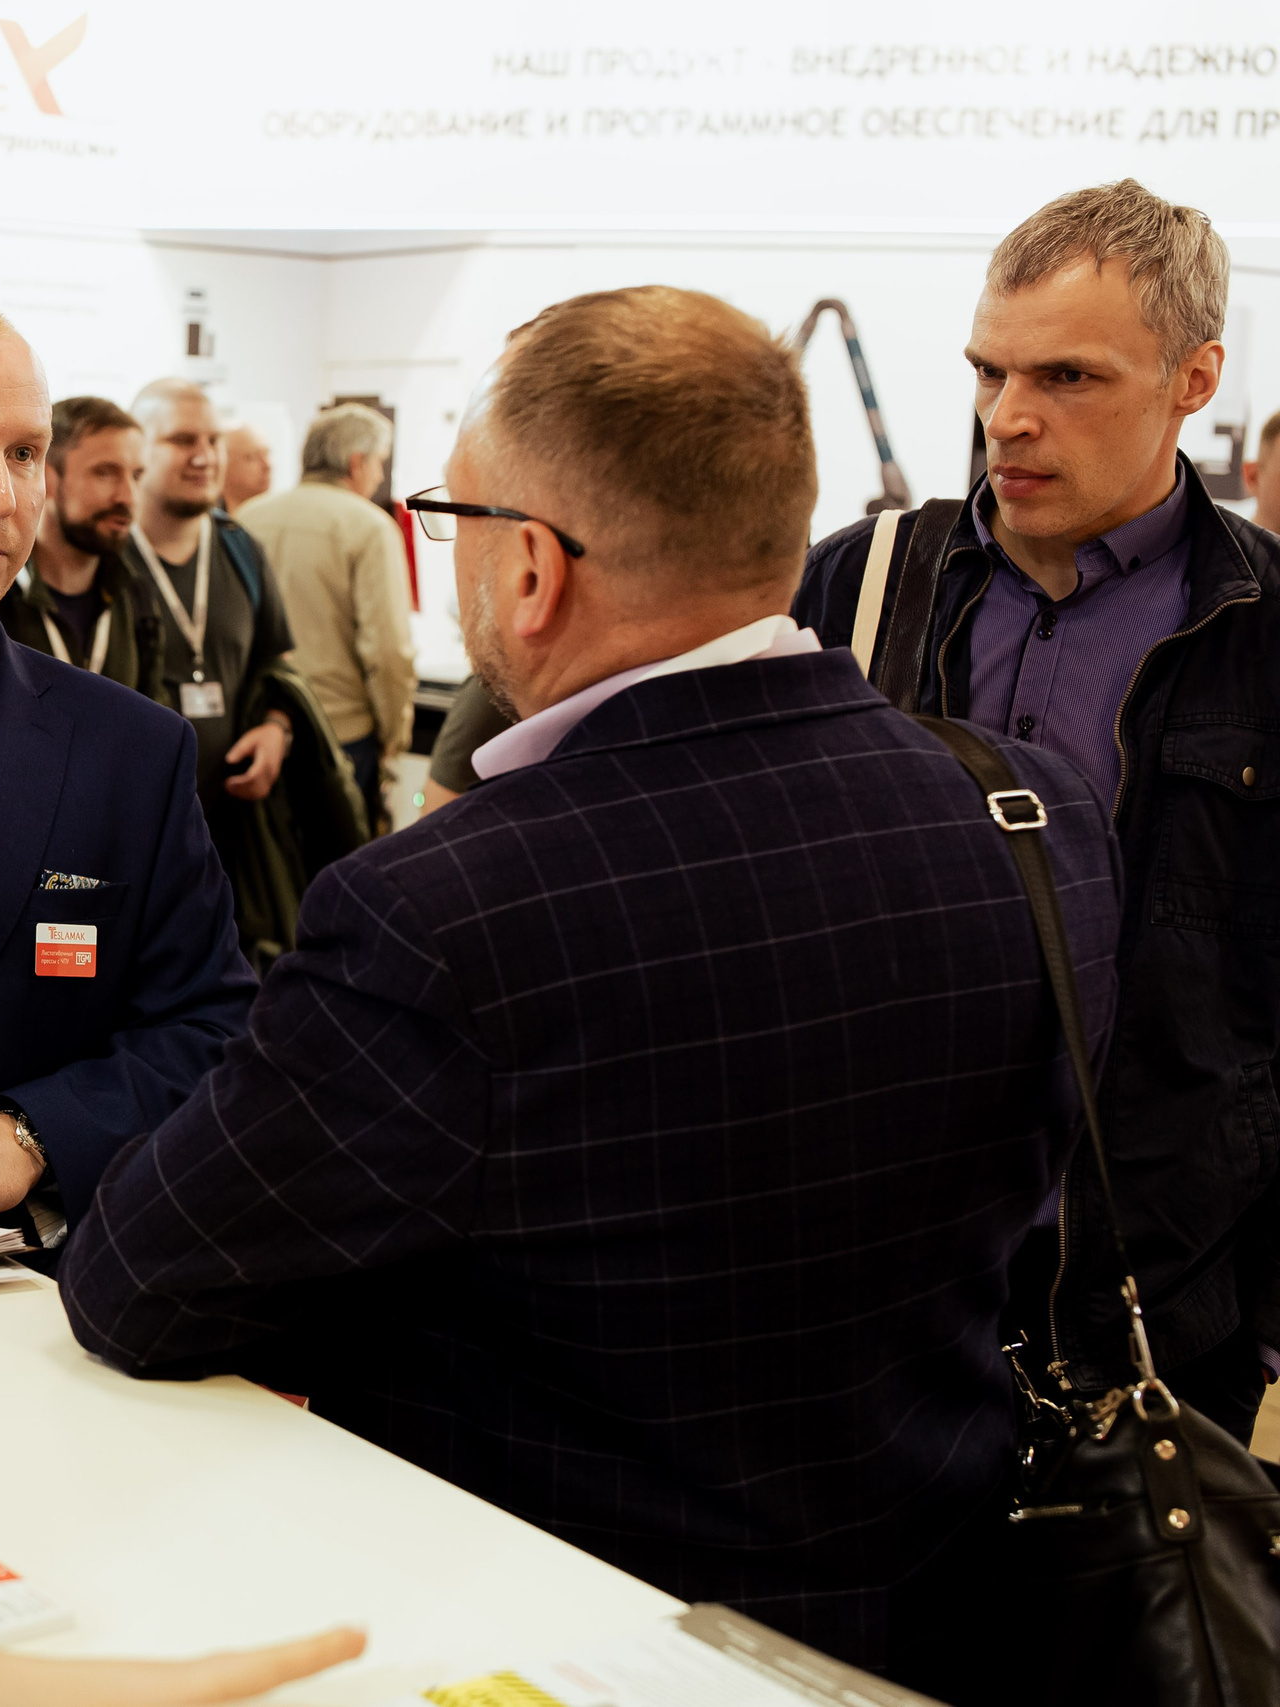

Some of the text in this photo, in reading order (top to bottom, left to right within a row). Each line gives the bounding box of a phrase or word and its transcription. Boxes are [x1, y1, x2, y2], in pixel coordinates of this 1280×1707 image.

[492, 47, 570, 77] НАШ
[791, 45, 1029, 80] ВНЕДРЕННОЕ
[1047, 46, 1070, 75] И
[1087, 43, 1278, 80] НАДЕЖНО
[262, 109, 532, 142] ОБОРУДОВАНИЕ
[545, 108, 570, 138] И
[583, 107, 848, 139] ПРОГРАММНОЕ
[862, 107, 1128, 139] ОБЕСПЕЧЕНИЕ
[1139, 108, 1220, 143] ДЛЯ
